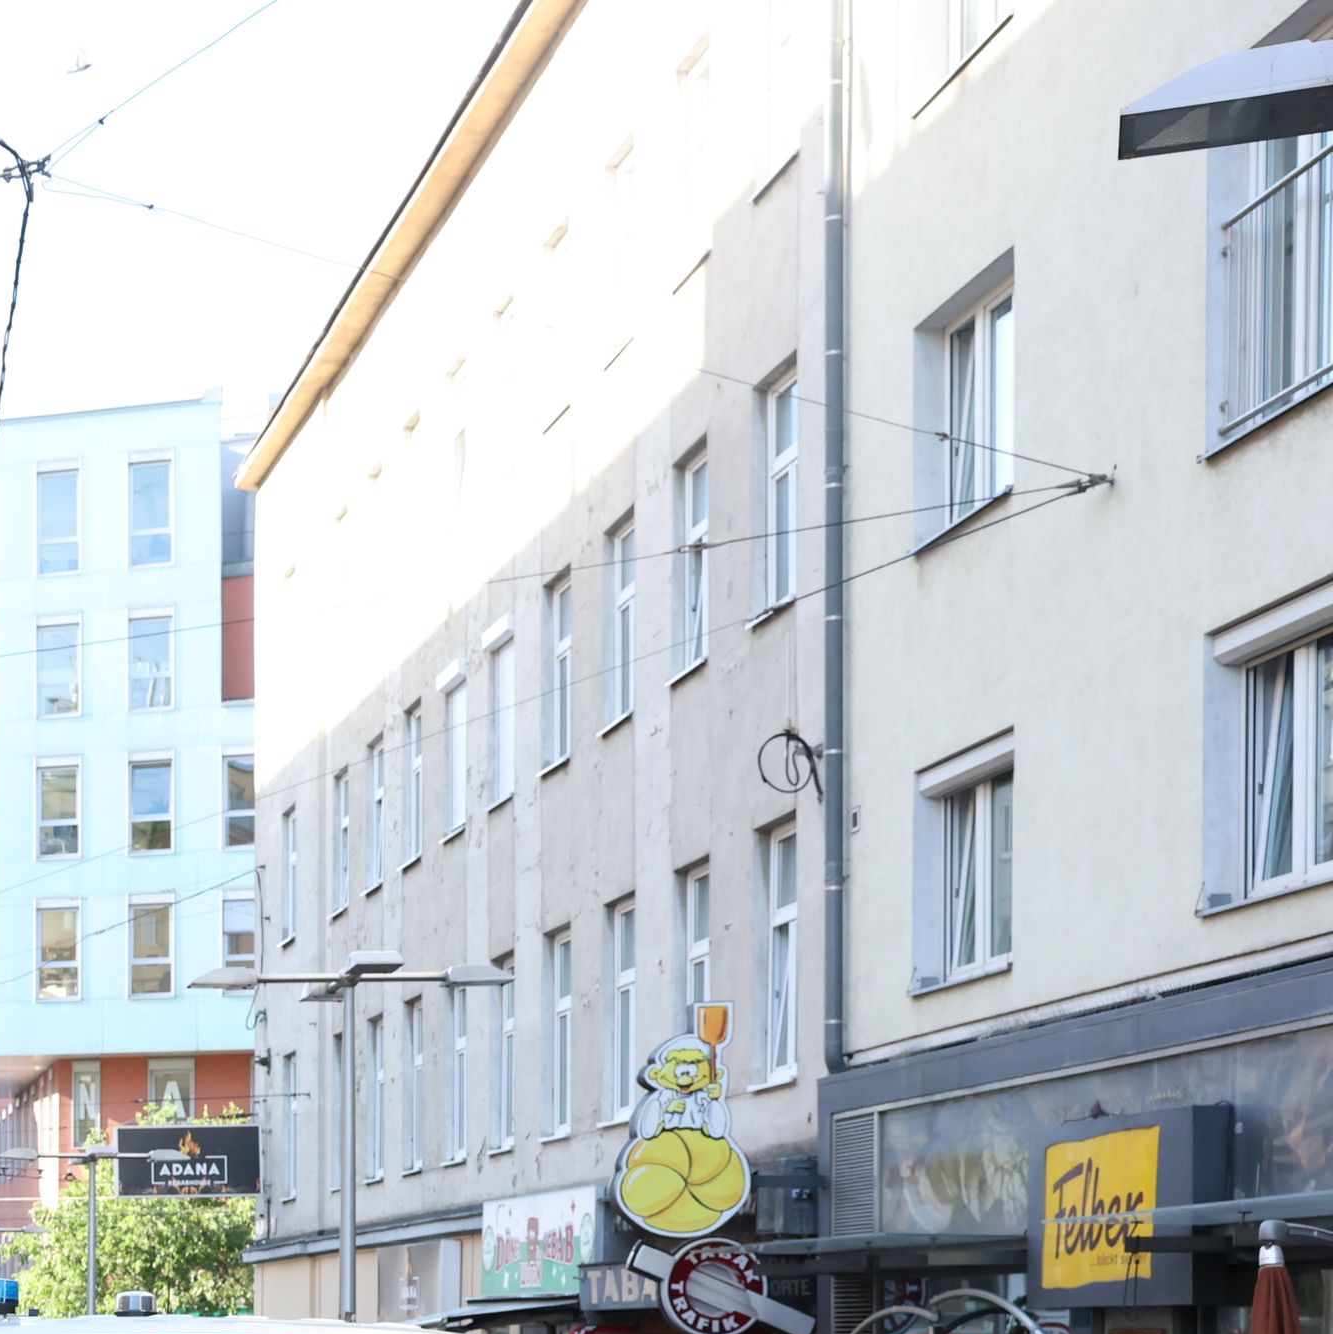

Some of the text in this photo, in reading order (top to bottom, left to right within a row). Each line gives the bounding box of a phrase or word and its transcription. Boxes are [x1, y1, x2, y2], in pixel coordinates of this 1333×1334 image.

[159, 1163, 220, 1176] ADANA
[1053, 1157, 1144, 1259] Felber
[671, 1281, 742, 1333] TRAFIK
